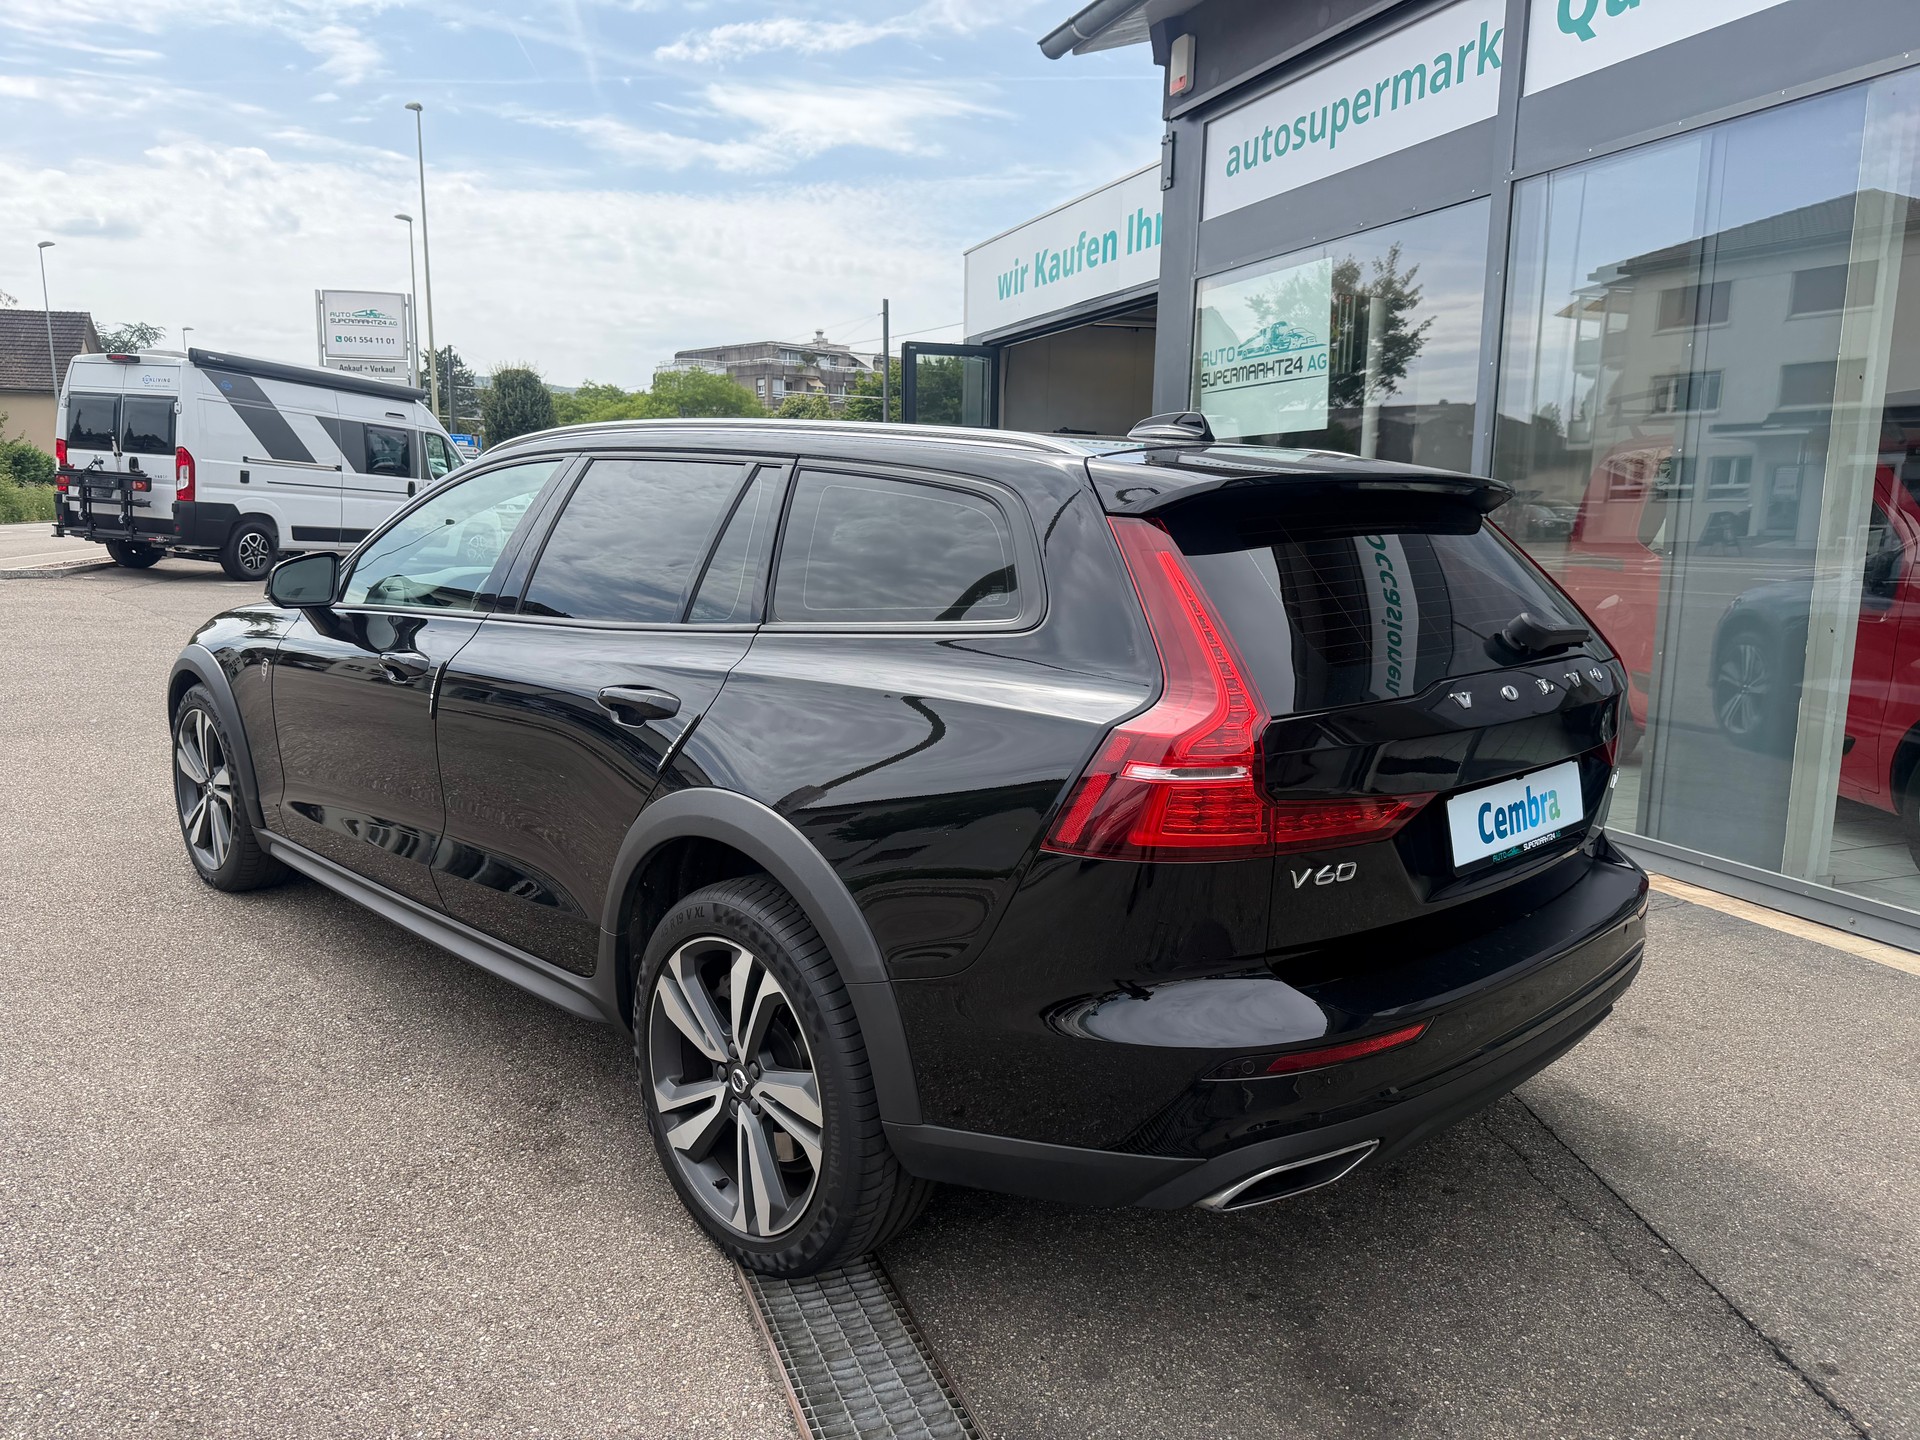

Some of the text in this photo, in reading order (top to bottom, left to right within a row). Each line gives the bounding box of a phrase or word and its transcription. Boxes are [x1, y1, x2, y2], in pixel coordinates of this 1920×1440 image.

[1226, 20, 1503, 178] autosupermark
[998, 258, 1028, 301] wir
[1034, 231, 1118, 288] Kaufen
[359, 336, 373, 344] 554
[1202, 346, 1236, 368] AUTO
[339, 364, 362, 372] Ankauf
[370, 365, 396, 373] Verkauf
[1201, 352, 1328, 389] SUPERMARKT24 AG
[1448, 667, 1603, 709] VOLVO
[1478, 785, 1561, 845] Cembra
[1290, 861, 1358, 889] V60
